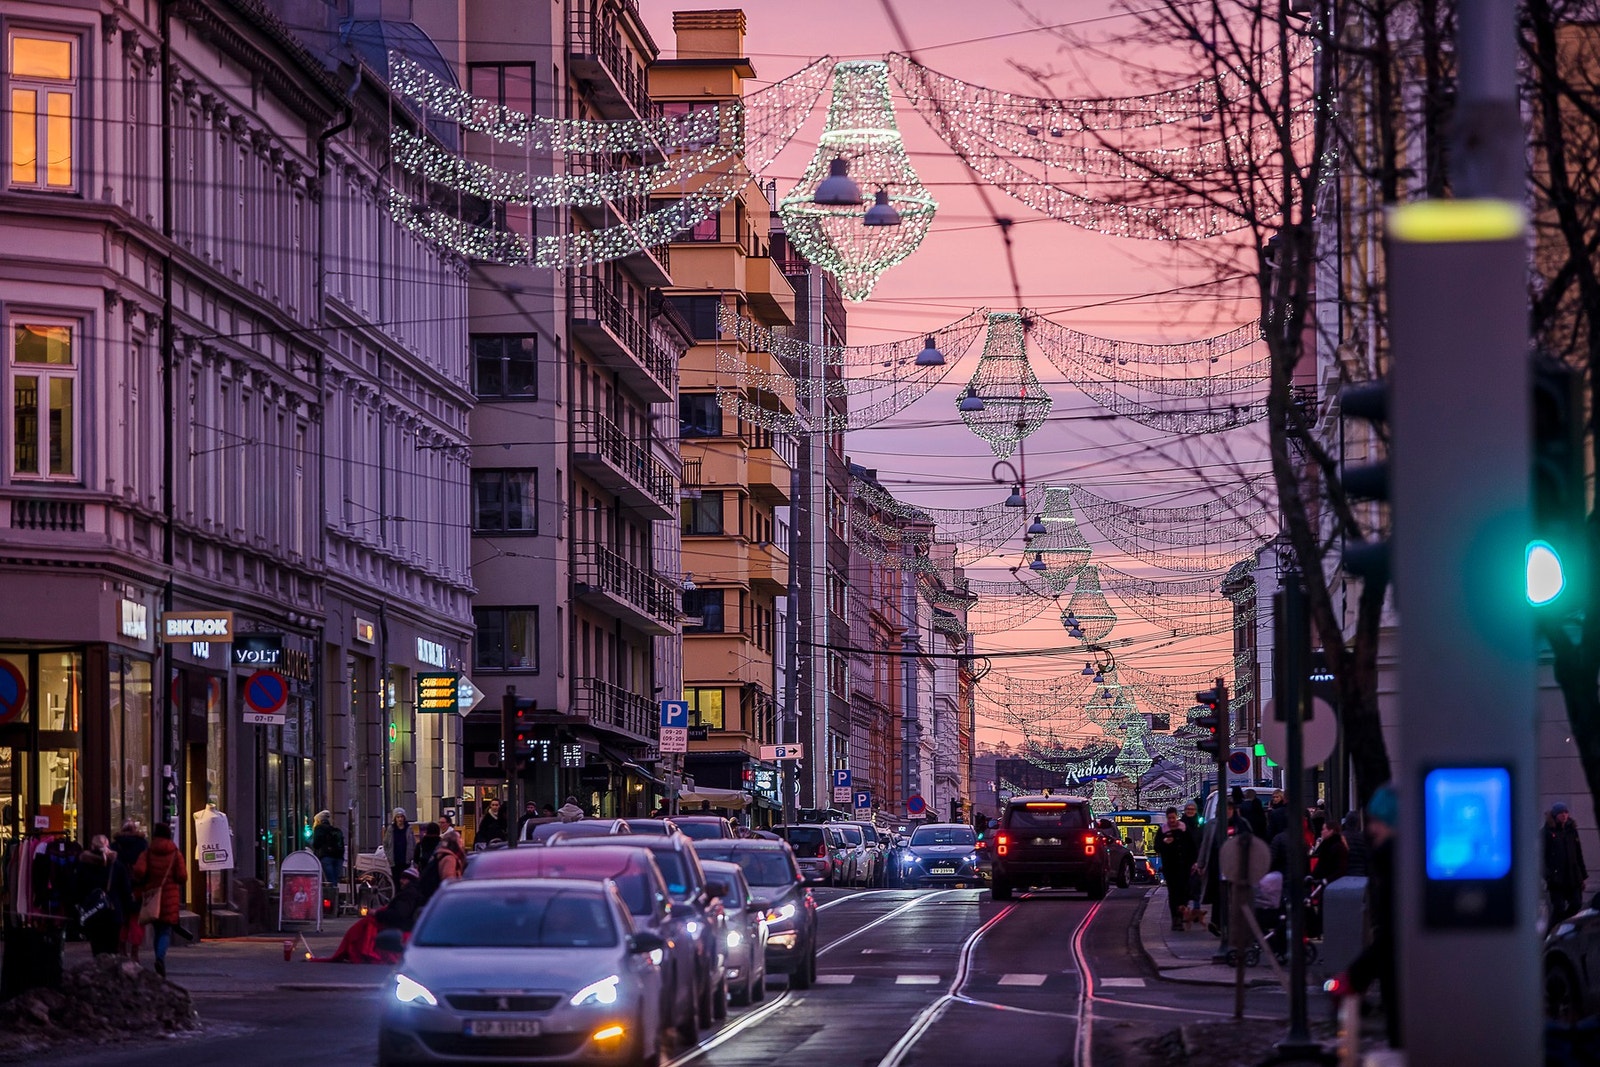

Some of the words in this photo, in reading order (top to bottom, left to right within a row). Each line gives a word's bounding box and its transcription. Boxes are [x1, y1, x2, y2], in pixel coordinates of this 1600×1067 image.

[236, 649, 279, 664] VOLT
[420, 678, 455, 687] SUBWAY
[420, 688, 455, 698] SUBWAY
[420, 698, 455, 708] SUBWAY
[255, 715, 274, 723] 07-17
[667, 703, 682, 725] P
[838, 771, 848, 785] P
[858, 793, 867, 807] P
